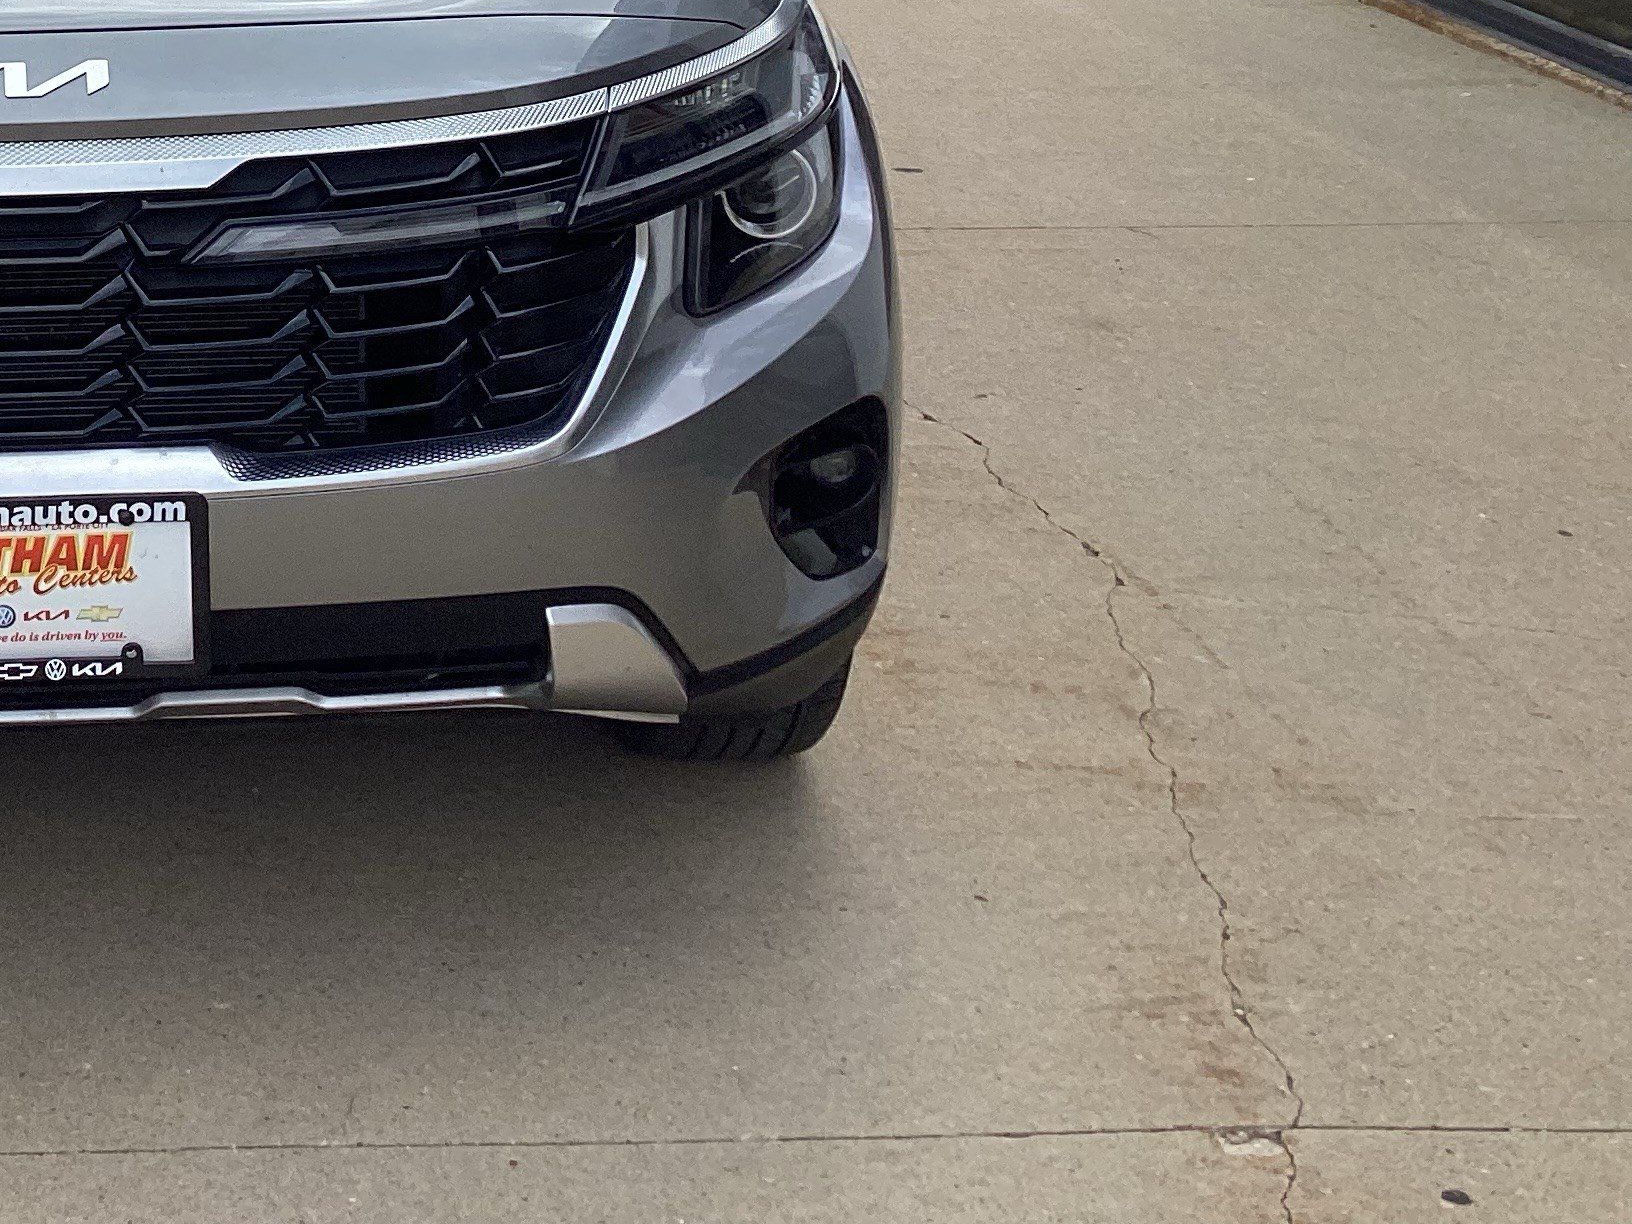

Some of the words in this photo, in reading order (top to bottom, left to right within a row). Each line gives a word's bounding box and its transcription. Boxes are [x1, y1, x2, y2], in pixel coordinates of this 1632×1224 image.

[33, 563, 137, 595] Centers
[10, 632, 26, 642] do
[29, 632, 39, 641] is
[42, 631, 81, 641] driven
[84, 630, 99, 642] by
[101, 630, 127, 642] you.
